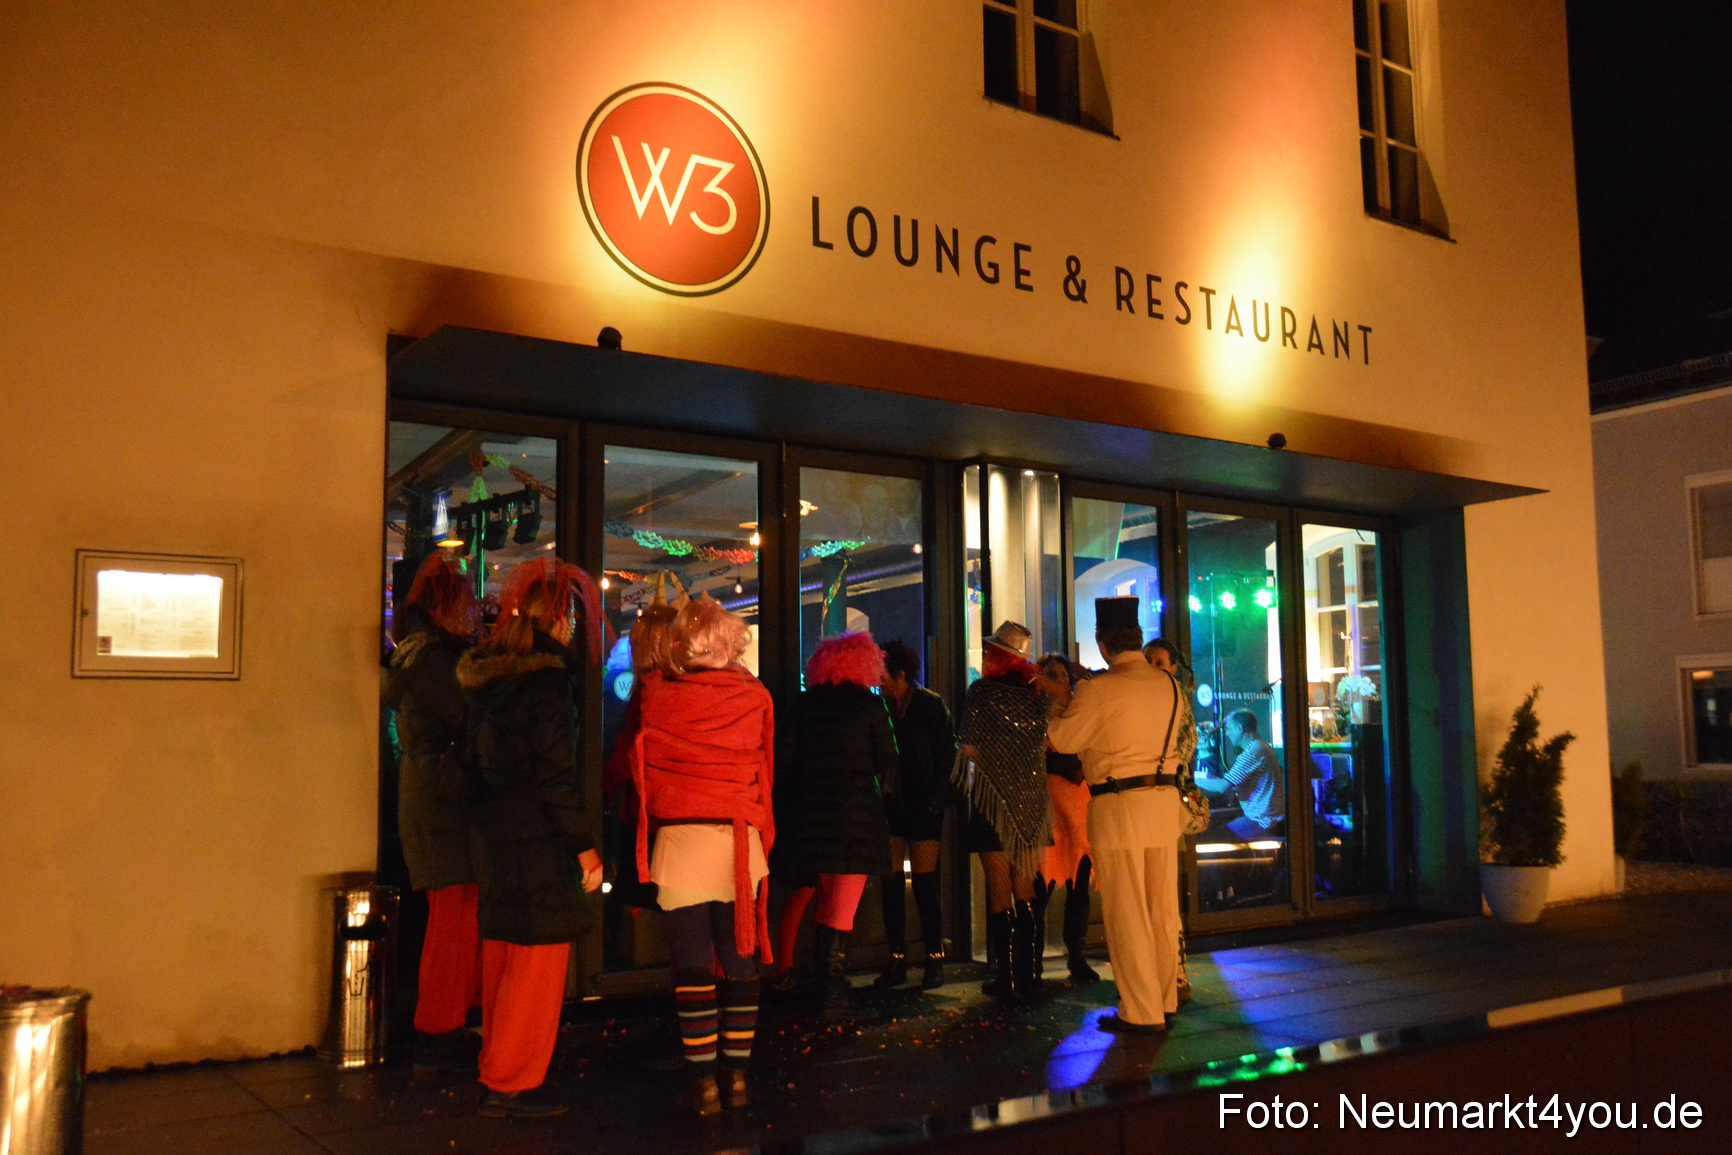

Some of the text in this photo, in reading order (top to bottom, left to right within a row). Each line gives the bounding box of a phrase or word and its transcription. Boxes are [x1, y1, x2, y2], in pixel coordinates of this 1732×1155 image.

[611, 134, 737, 236] W3
[811, 195, 1373, 366] LOUNGE & RESTAURANT
[1215, 691, 1237, 700] LOUNGE
